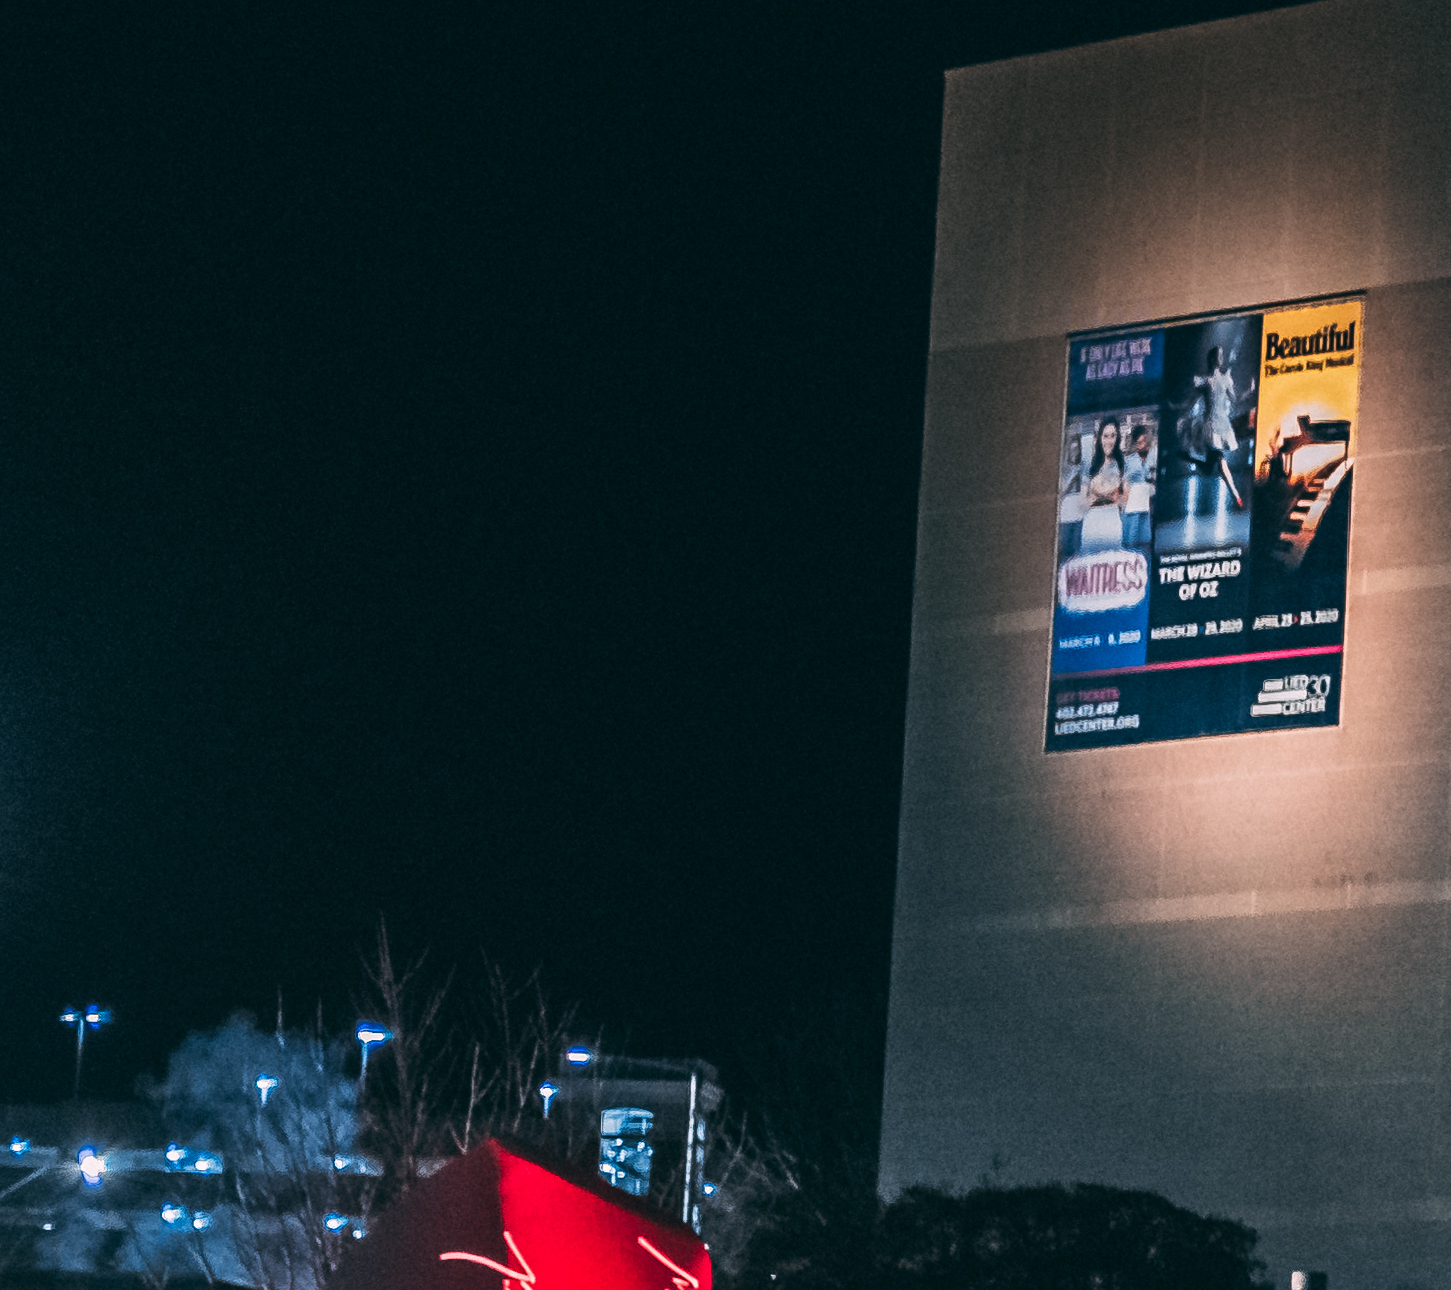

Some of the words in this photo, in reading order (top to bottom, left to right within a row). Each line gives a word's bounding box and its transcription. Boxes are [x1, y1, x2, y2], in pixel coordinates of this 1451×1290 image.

[1266, 320, 1355, 361] Beautiful
[1065, 557, 1143, 596] WAITRESS
[1159, 566, 1185, 584] THE
[1187, 560, 1241, 580] WIZARD
[1178, 583, 1197, 601] OF
[1199, 581, 1219, 598] OZ
[1151, 625, 1186, 640] MARCH
[1282, 697, 1326, 715] CENTER
